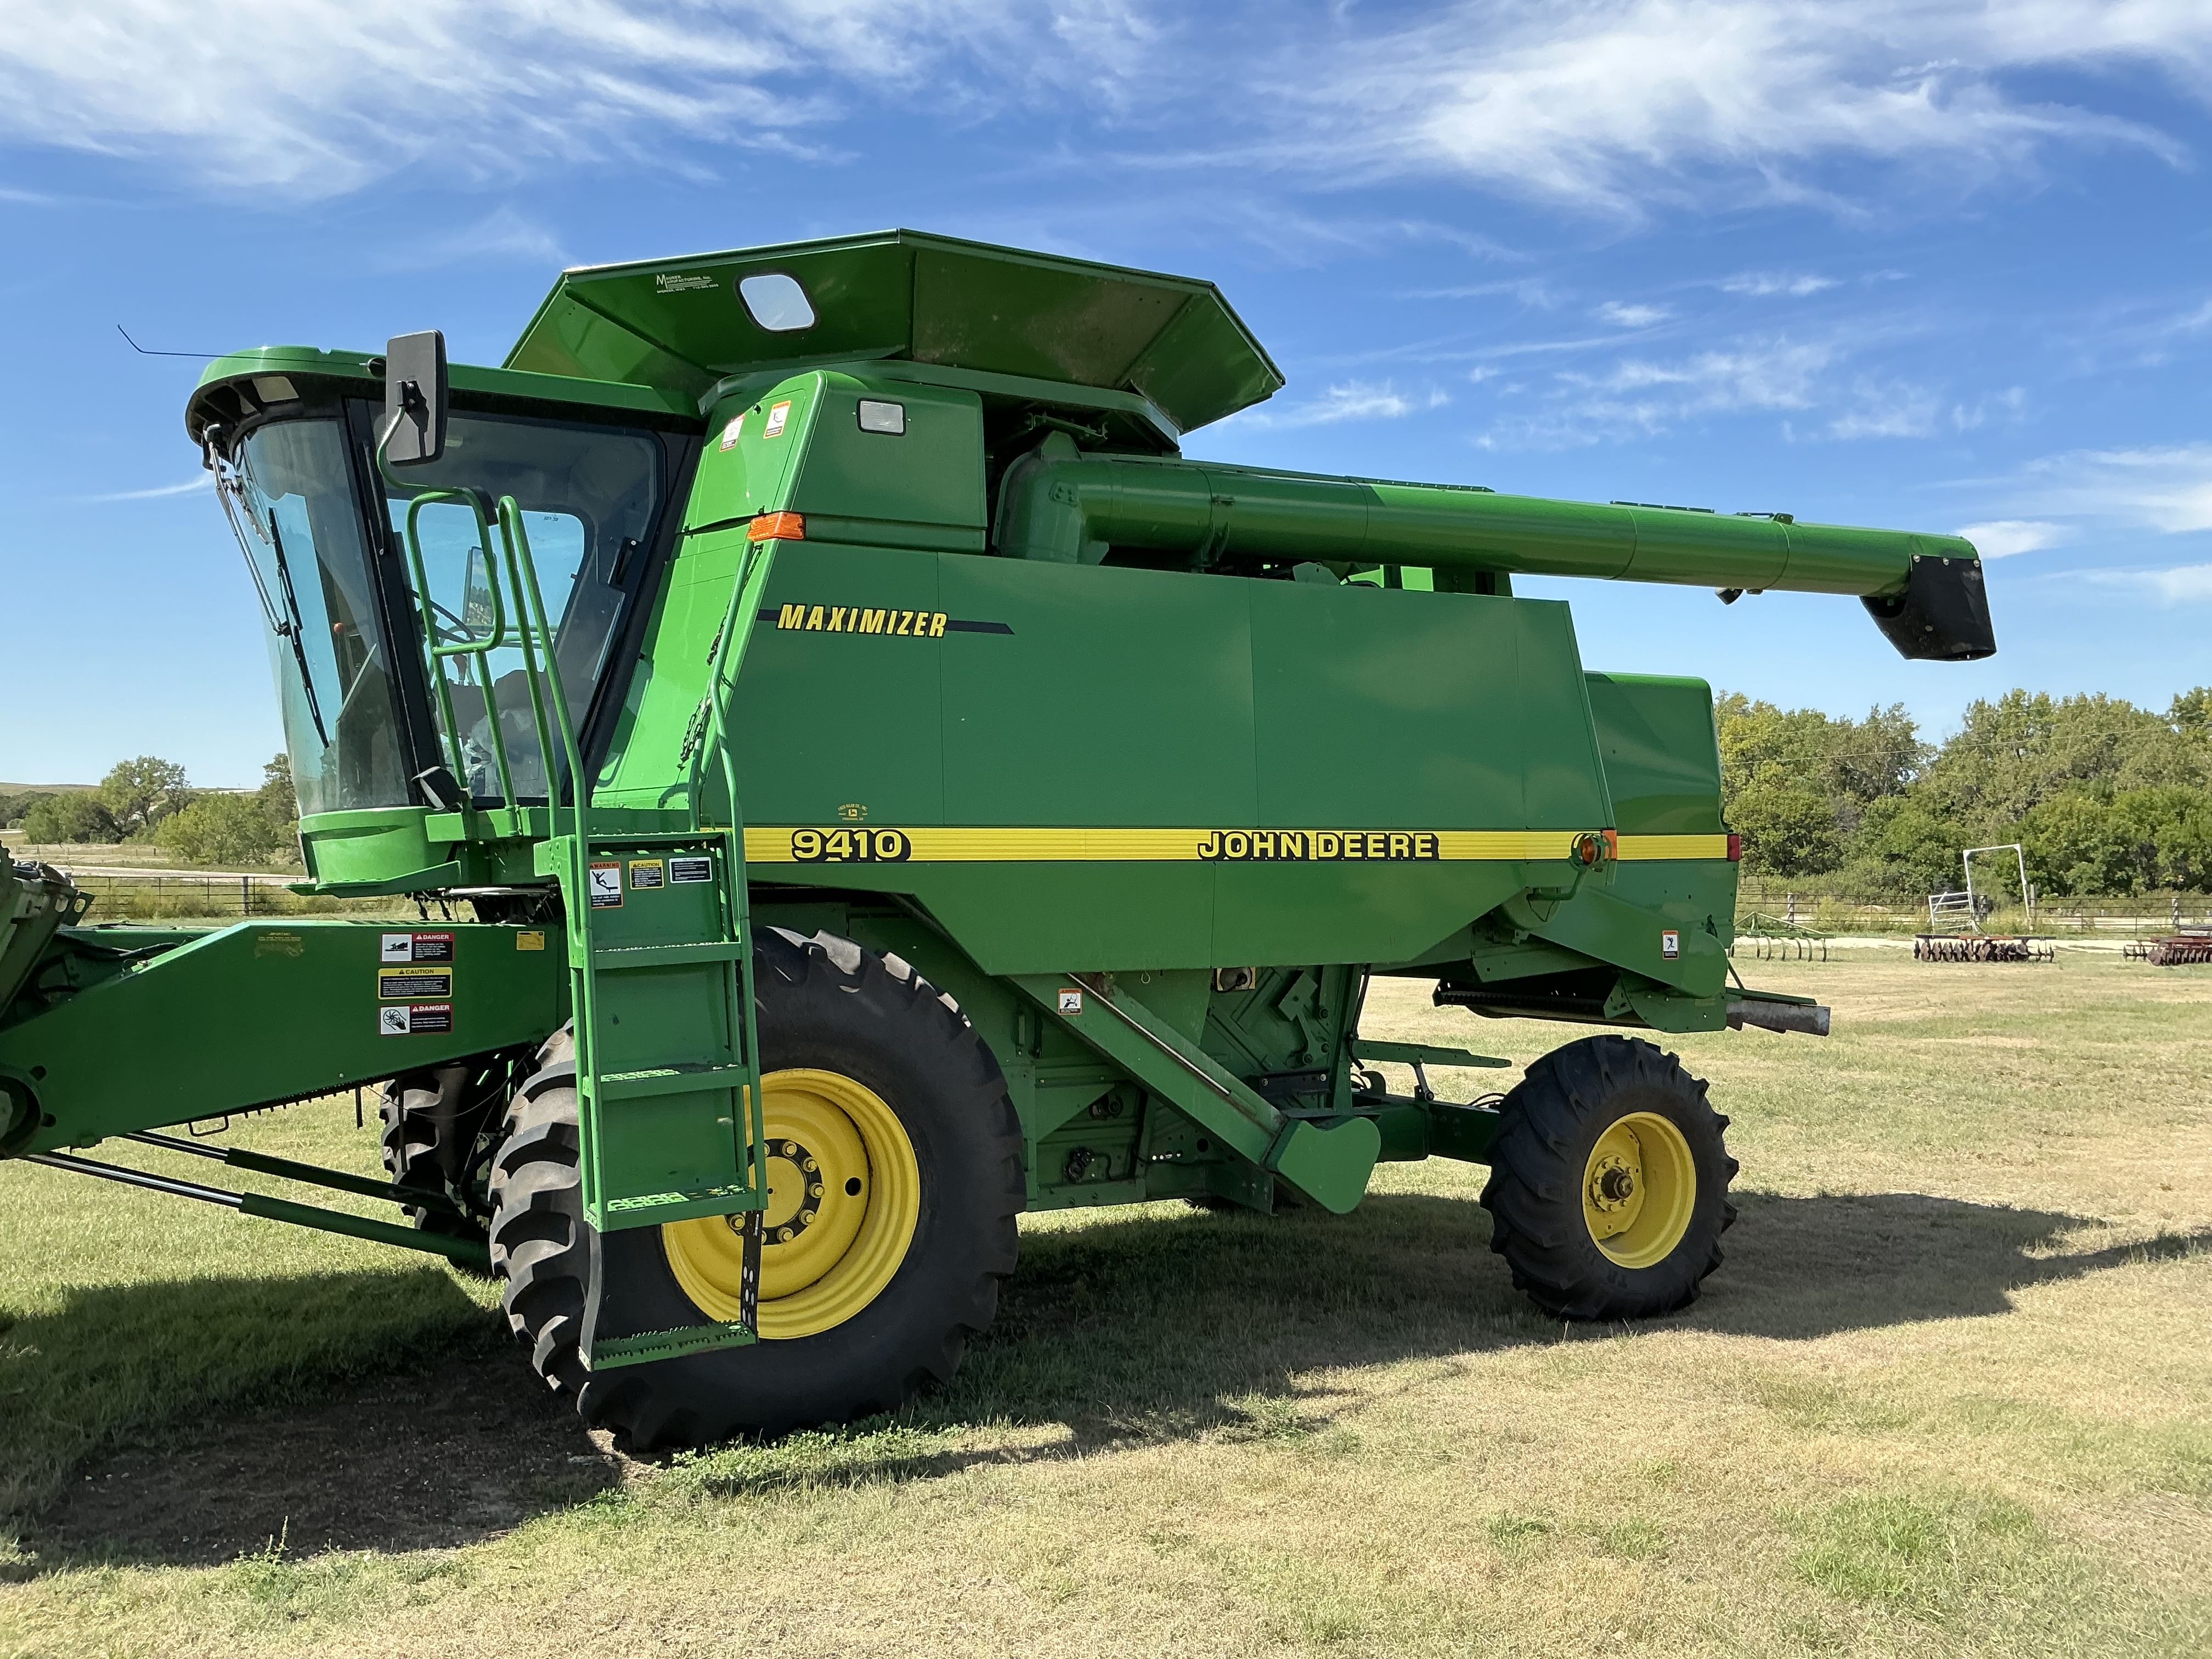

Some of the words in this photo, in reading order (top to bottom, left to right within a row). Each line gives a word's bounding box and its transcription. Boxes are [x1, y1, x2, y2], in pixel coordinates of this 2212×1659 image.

[777, 602, 949, 638] MAXIMIZER
[792, 830, 909, 861] 9410
[1198, 831, 1308, 860] JOHN
[1317, 832, 1438, 860] DEERE
